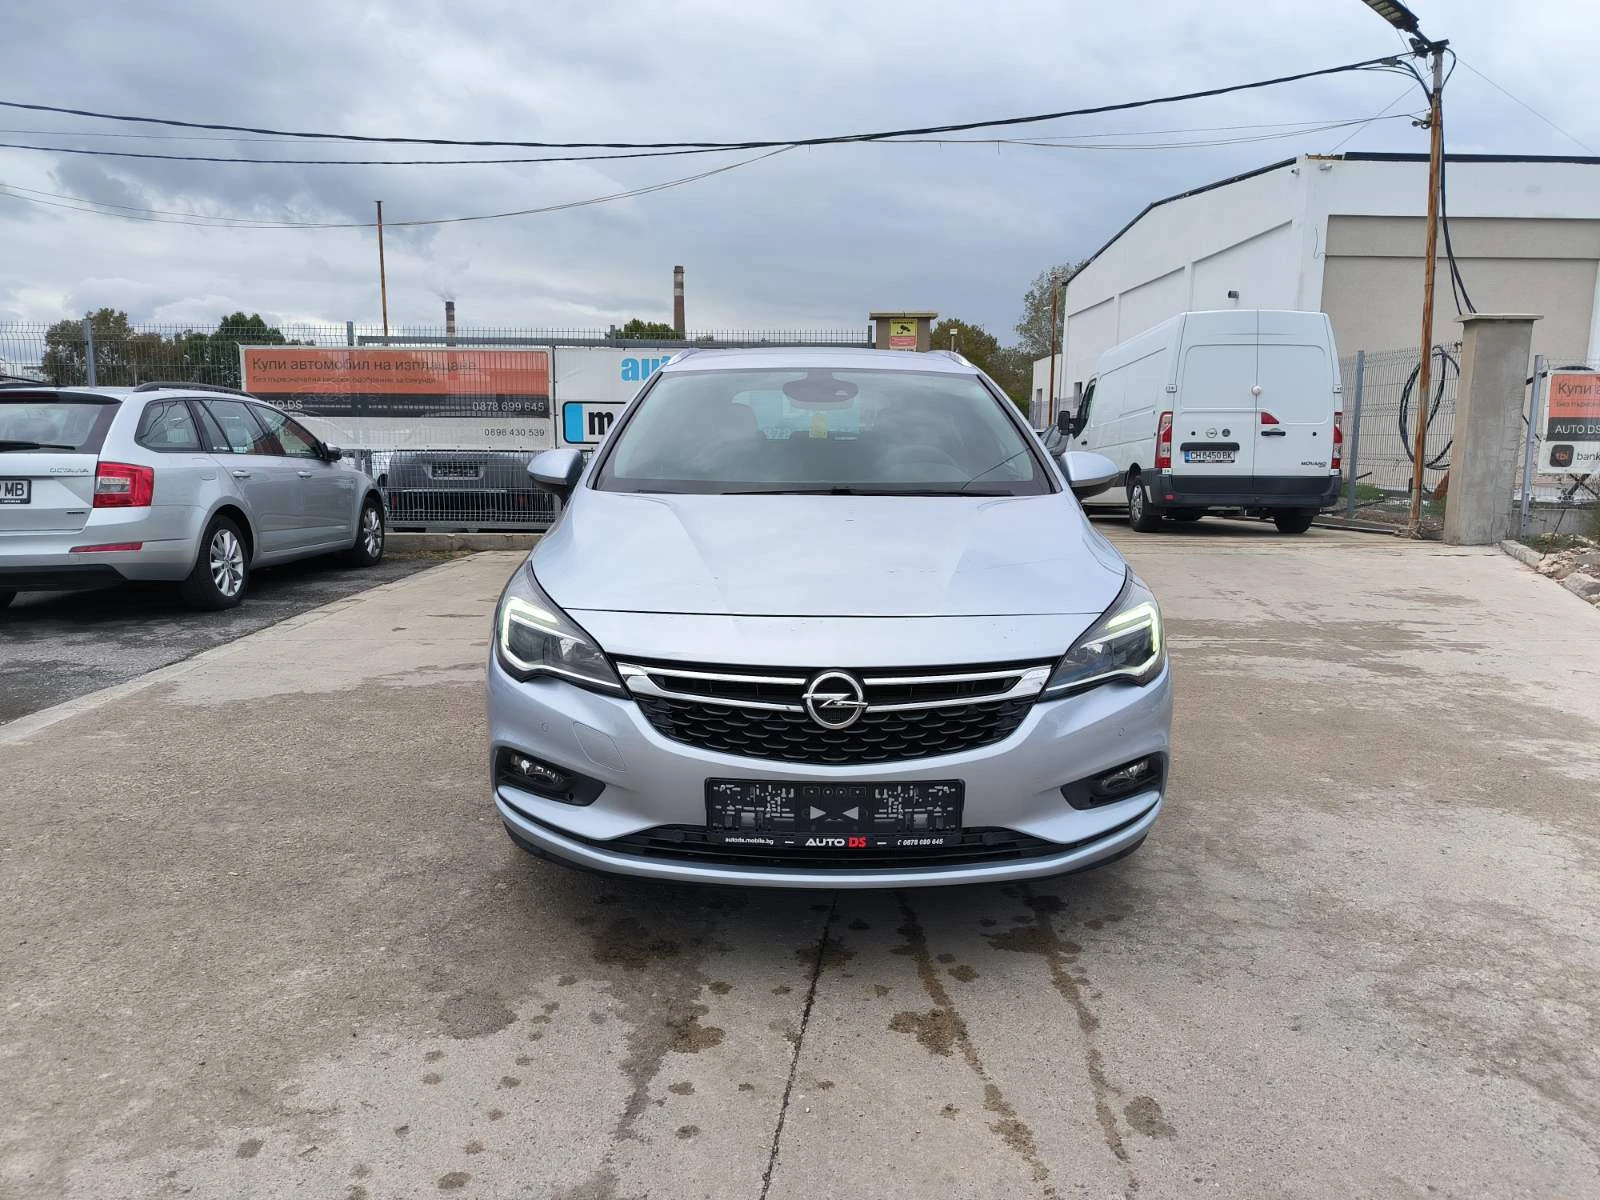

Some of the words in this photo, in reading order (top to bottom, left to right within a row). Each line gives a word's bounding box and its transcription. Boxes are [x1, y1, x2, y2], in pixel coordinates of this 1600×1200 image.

[253, 358, 286, 371] Купи
[289, 358, 370, 370] автомобил
[374, 361, 391, 370] на
[1558, 383, 1592, 396] Купи
[287, 400, 303, 409] DS
[472, 401, 499, 411] 0878
[501, 402, 522, 411] 699
[524, 402, 545, 411] 645
[509, 429, 526, 437] 430
[528, 429, 545, 437] 539
[1555, 424, 1585, 434] AUTO
[1587, 424, 1600, 434] DS
[1576, 451, 1600, 461] bank
[4, 482, 25, 497] MB
[805, 838, 845, 847] AUTO
[848, 837, 866, 848] DS
